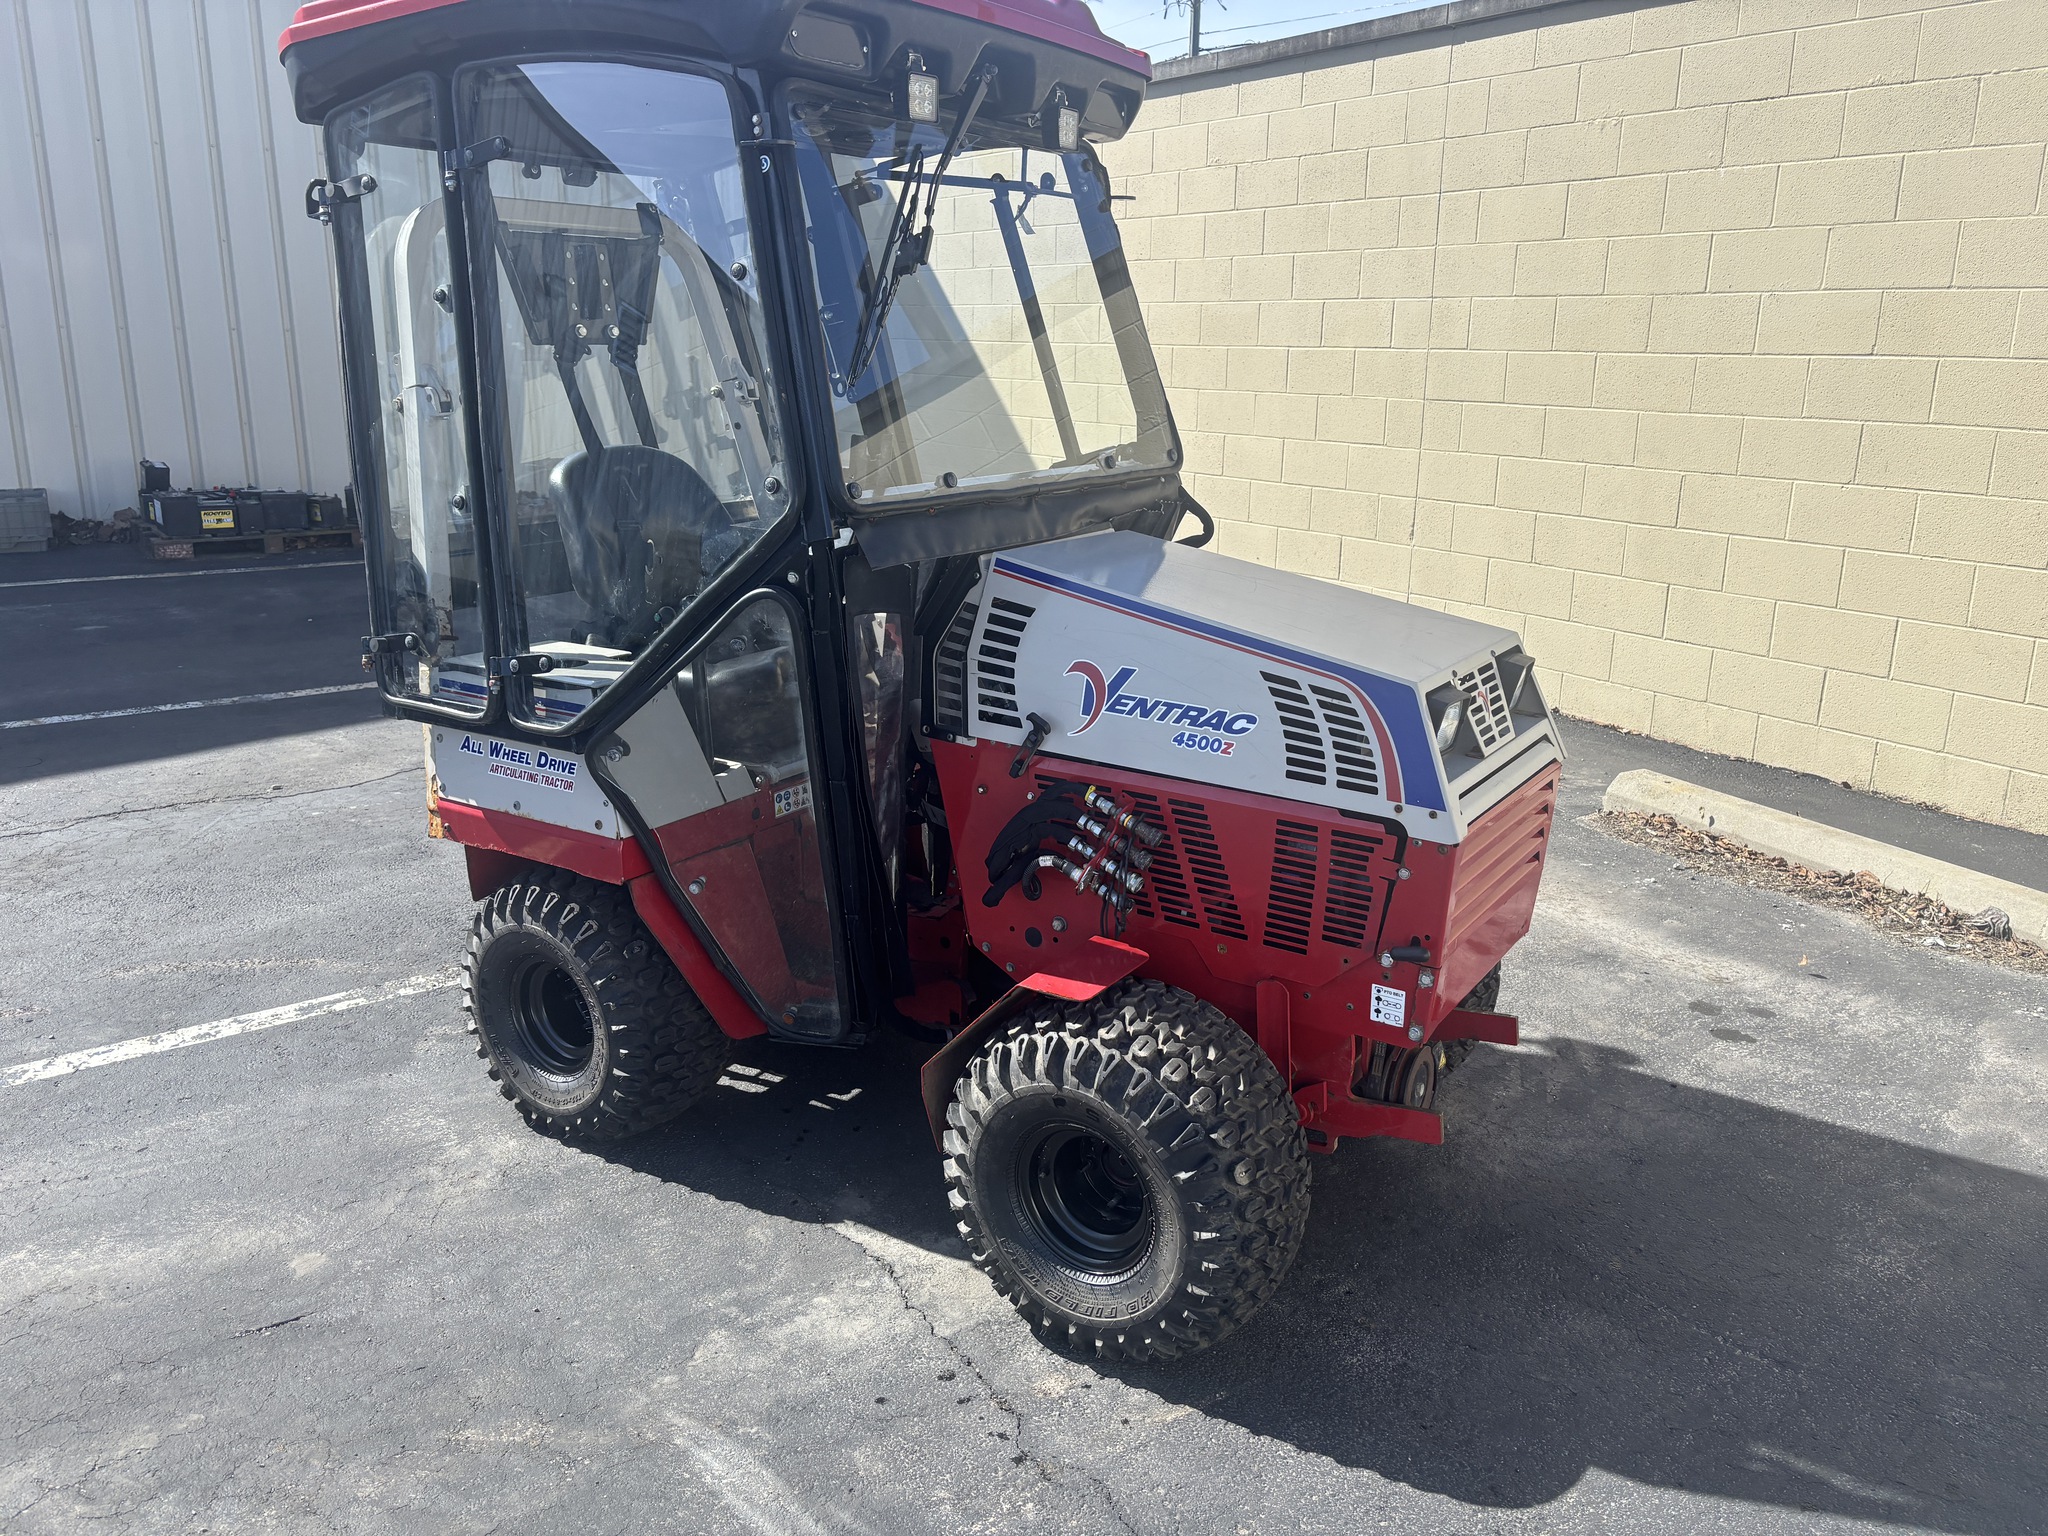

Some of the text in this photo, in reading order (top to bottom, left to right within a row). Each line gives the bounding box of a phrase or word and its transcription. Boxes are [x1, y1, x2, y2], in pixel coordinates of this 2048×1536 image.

[1063, 660, 1259, 736] VENTRAC
[488, 740, 533, 766] WHEEL
[536, 751, 578, 776] DRIVE
[1171, 731, 1236, 757] 4500Z
[488, 763, 575, 793] ARTICULATING TRACTOR
